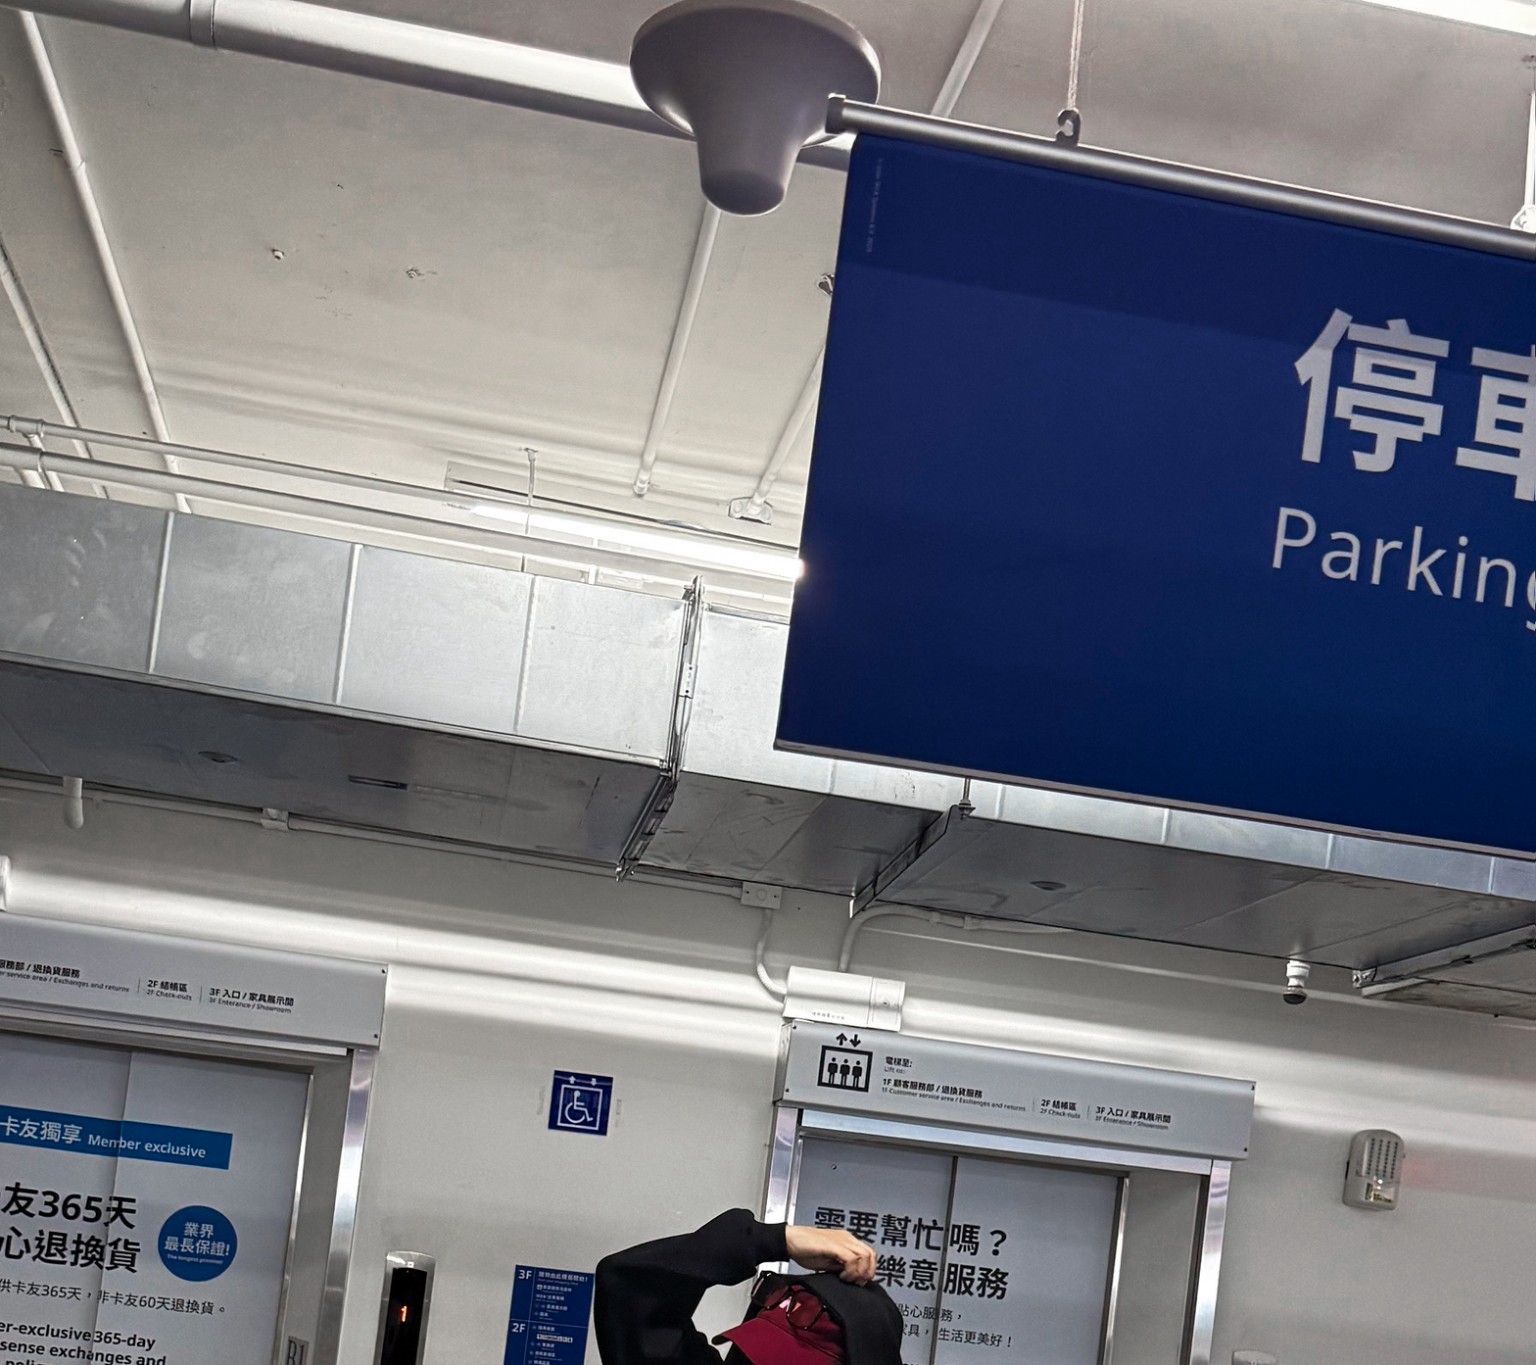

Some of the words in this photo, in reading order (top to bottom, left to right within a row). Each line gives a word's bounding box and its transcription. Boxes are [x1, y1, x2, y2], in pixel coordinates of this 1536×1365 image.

[147, 979, 158, 988] 2F
[209, 988, 220, 997] 3F
[222, 988, 241, 999] 入口
[882, 1078, 892, 1086] 1F
[1041, 1099, 1051, 1107] 2F
[1096, 1106, 1105, 1114] 3F
[1107, 1107, 1124, 1117] 入口
[0, 1116, 83, 1144] 卡友獨享
[88, 1134, 142, 1151] Member
[144, 1142, 207, 1158] exclusive
[0, 1182, 137, 1230] 友365天
[184, 1221, 214, 1239] 業界
[0, 1226, 141, 1273] 心退換貨
[518, 1269, 532, 1280] 3F
[875, 1255, 1010, 1300] 樂意服務
[400, 1305, 408, 1322] 1
[511, 1322, 526, 1333] 2F
[93, 1330, 157, 1351] 365-day
